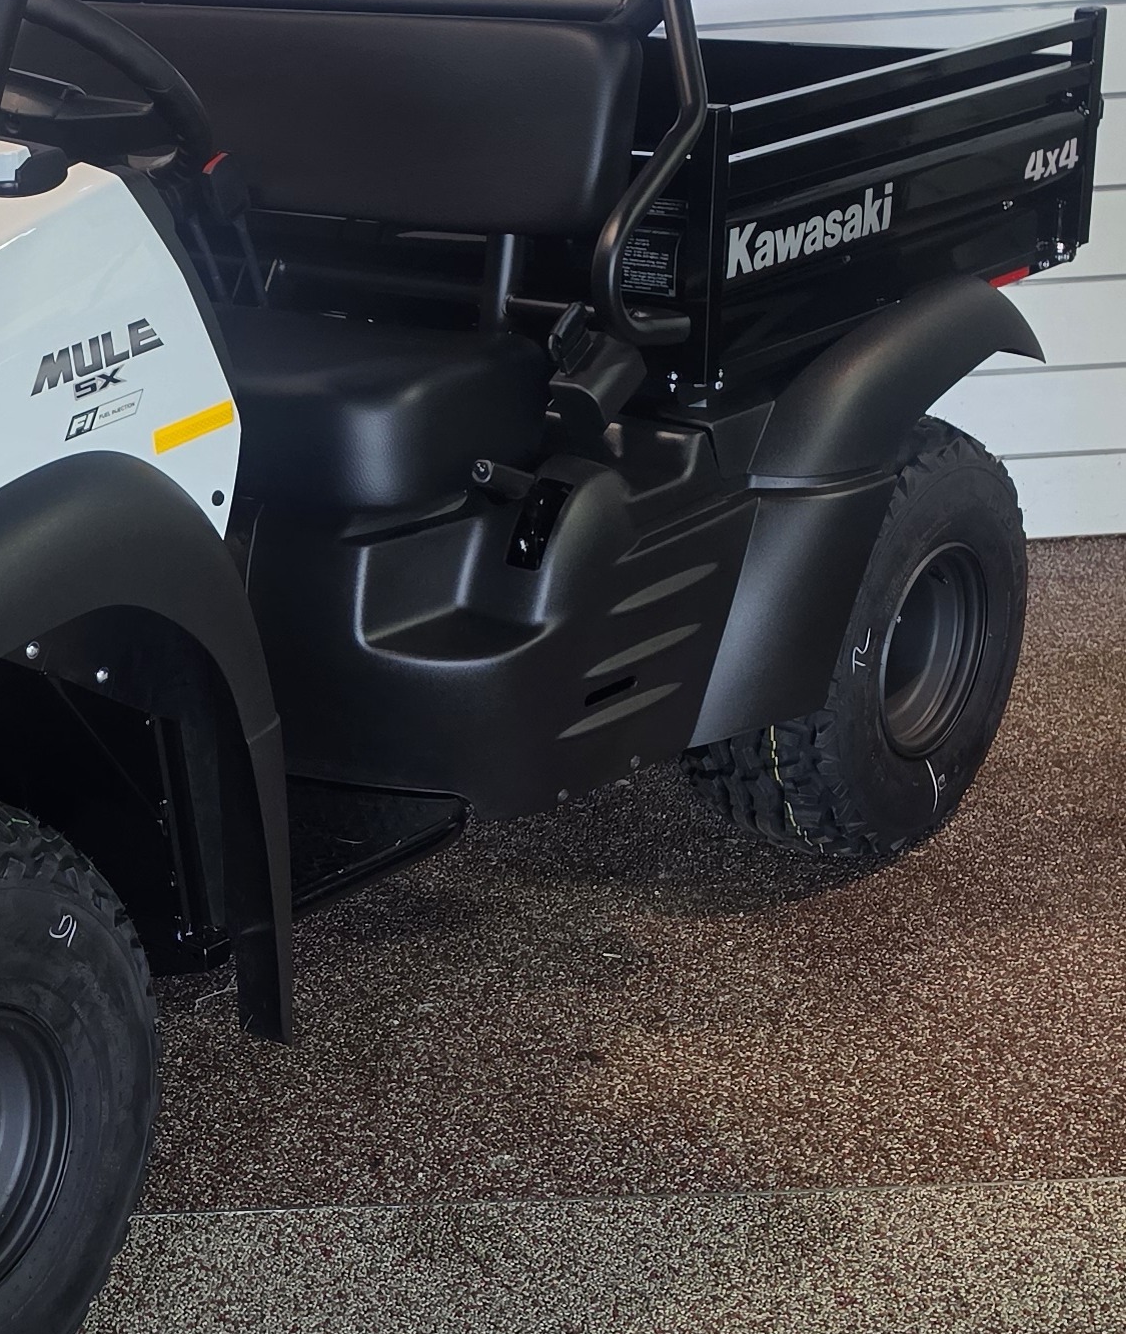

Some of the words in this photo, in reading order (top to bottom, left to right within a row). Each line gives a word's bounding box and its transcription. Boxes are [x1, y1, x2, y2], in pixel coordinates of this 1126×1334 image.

[1024, 137, 1079, 181] 4x4
[726, 182, 894, 279] Kawasaki
[31, 318, 164, 397] MULE
[74, 365, 126, 400] SX
[98, 410, 111, 421] FUEL
[111, 402, 136, 415] INJECTION
